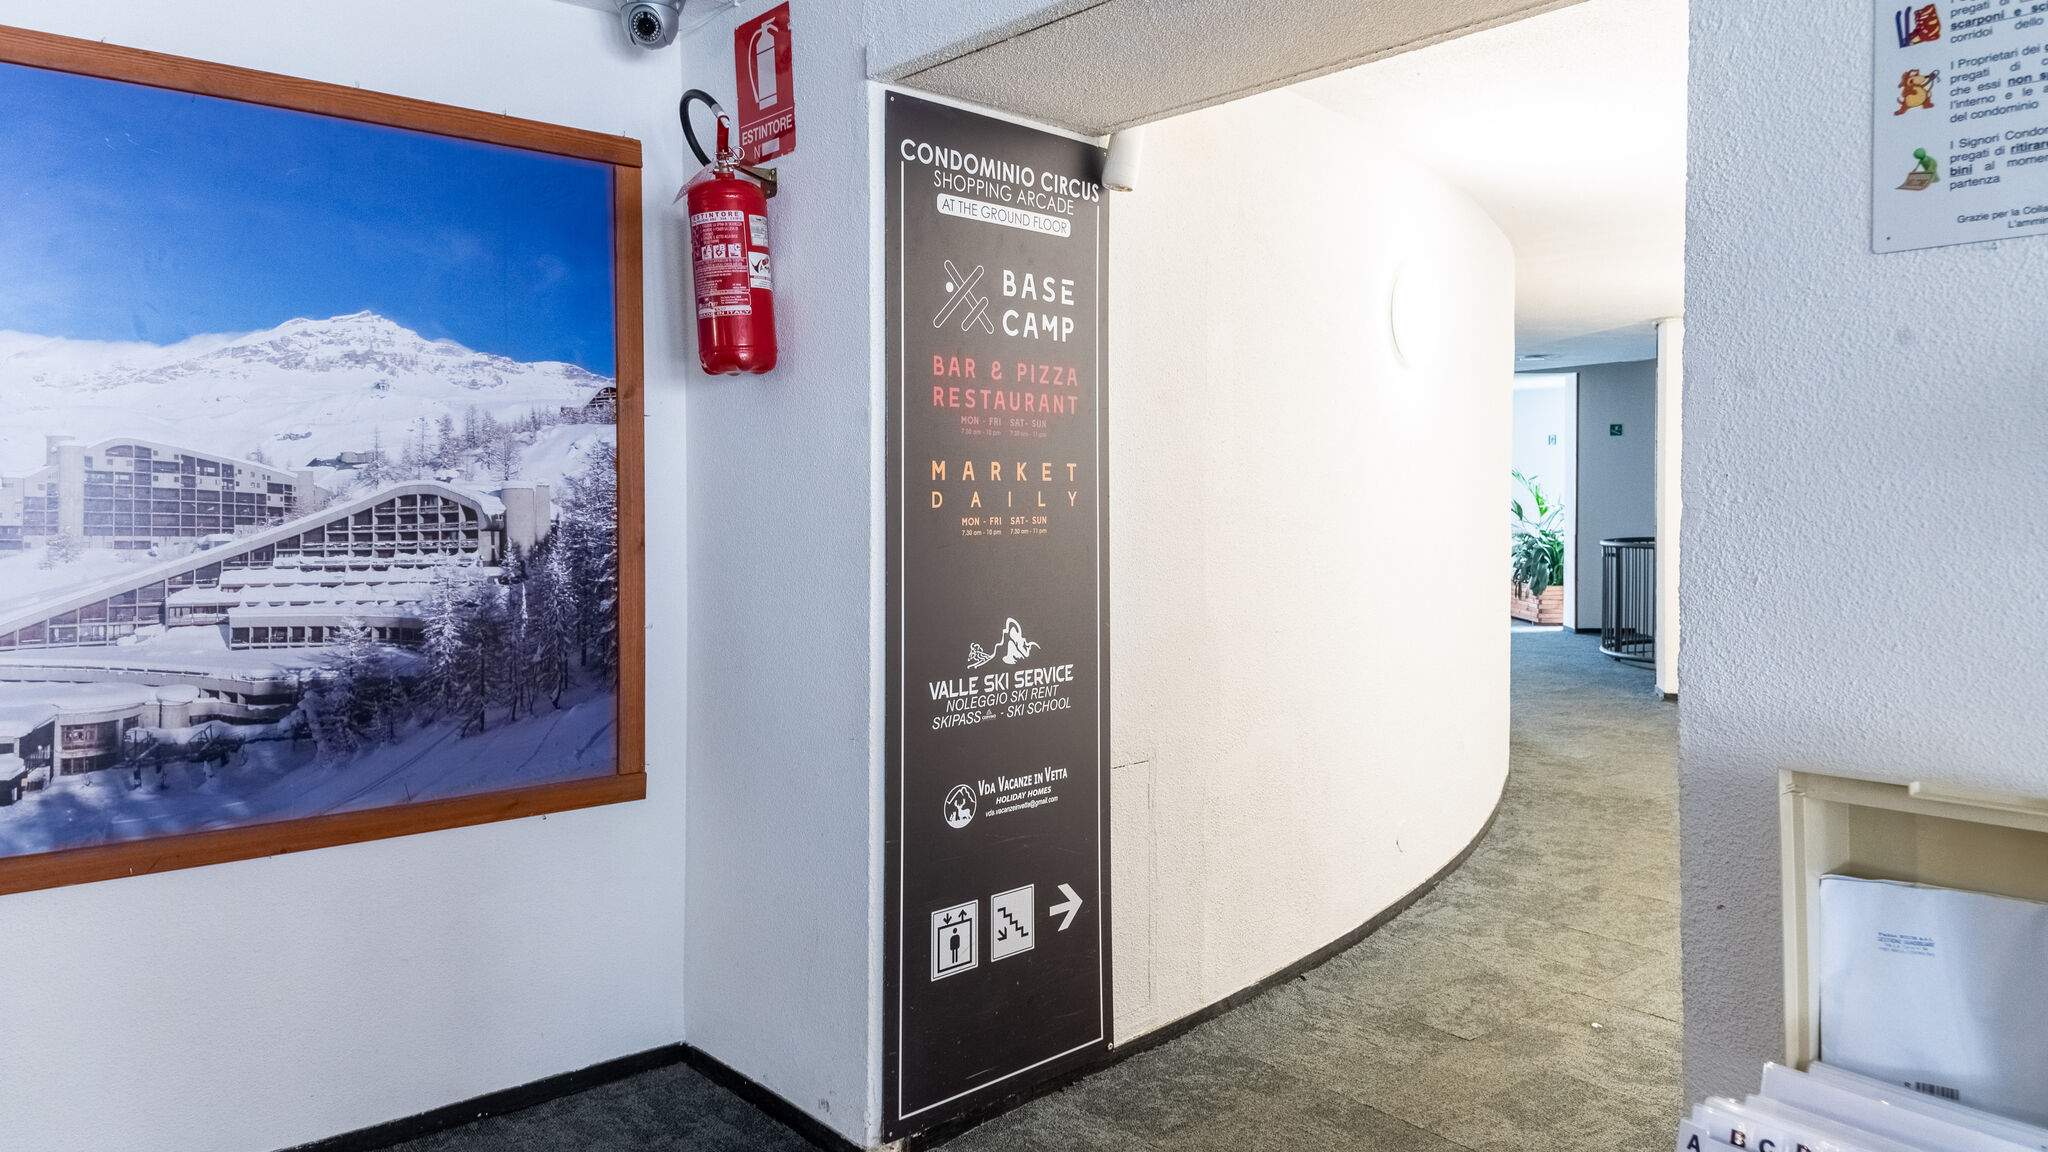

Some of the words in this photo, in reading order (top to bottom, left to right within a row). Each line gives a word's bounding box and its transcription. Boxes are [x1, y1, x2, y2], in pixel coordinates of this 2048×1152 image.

[1950, 1, 1990, 19] pregati
[1950, 10, 2005, 31] scarponi
[2014, 8, 2022, 17] e
[1950, 26, 1993, 44] corridoi
[2014, 17, 2045, 30] dello
[1958, 47, 2018, 68] Proprietari
[2021, 43, 2041, 56] dei
[1950, 67, 1990, 85] pregati
[2009, 61, 2021, 72] di
[1950, 86, 1971, 97] che
[1977, 79, 2001, 92] essi
[2007, 75, 2032, 87] non
[1950, 95, 1996, 110] l'interno
[2004, 92, 2013, 100] e
[2022, 87, 2034, 97] le
[1950, 111, 1967, 123] del
[1970, 100, 2039, 120] condominio
[741, 114, 793, 146] ESTINTORE
[1959, 134, 2000, 149] Signori
[1950, 148, 1990, 165] pregati
[1994, 145, 2006, 156] di
[900, 138, 1036, 188] CONDOMINIO
[1040, 171, 1100, 203] CIRCUS
[1950, 164, 1973, 178] bini
[1984, 160, 1996, 171] al
[933, 169, 1012, 202] SHOPPING
[1016, 189, 1075, 216] ARCADE
[1950, 175, 2001, 191] partenza
[941, 199, 956, 212] AT
[958, 201, 978, 216] THE
[980, 206, 1031, 227] GROUND
[1033, 216, 1067, 234] FLOOR
[1957, 212, 1990, 224] Grazie
[1991, 211, 2008, 221] per
[2010, 208, 2021, 217] la
[1002, 269, 1075, 306] BASE
[1002, 309, 1075, 343] CAMP
[933, 355, 976, 379] BAR
[991, 360, 1003, 381] &
[1017, 362, 1079, 387] PIZZA
[933, 385, 1079, 416] RESTAURANT
[961, 416, 979, 425] MON
[988, 417, 1002, 427] FRI
[1031, 419, 1048, 429] SUN
[931, 460, 1078, 482] MARKET
[931, 490, 1078, 509] DAILY
[961, 517, 980, 526] MON
[989, 516, 1002, 525] FRI
[1031, 516, 1047, 525] SUN
[928, 675, 980, 700] VALLE
[983, 672, 1010, 693] SKI
[1013, 663, 1075, 689] SERVICE
[945, 691, 1008, 713] NOLEGGIO
[1010, 689, 1029, 703] SKI
[1030, 684, 1060, 700] RENT
[931, 710, 982, 730] SKIPASS
[1006, 703, 1025, 718] SKI
[1026, 696, 1072, 715] SCHOOL
[995, 791, 1027, 805] HOLIDAY
[1027, 785, 1052, 798] HOMES
[1686, 1133, 1701, 1152] A
[1729, 1128, 1747, 1149] B
